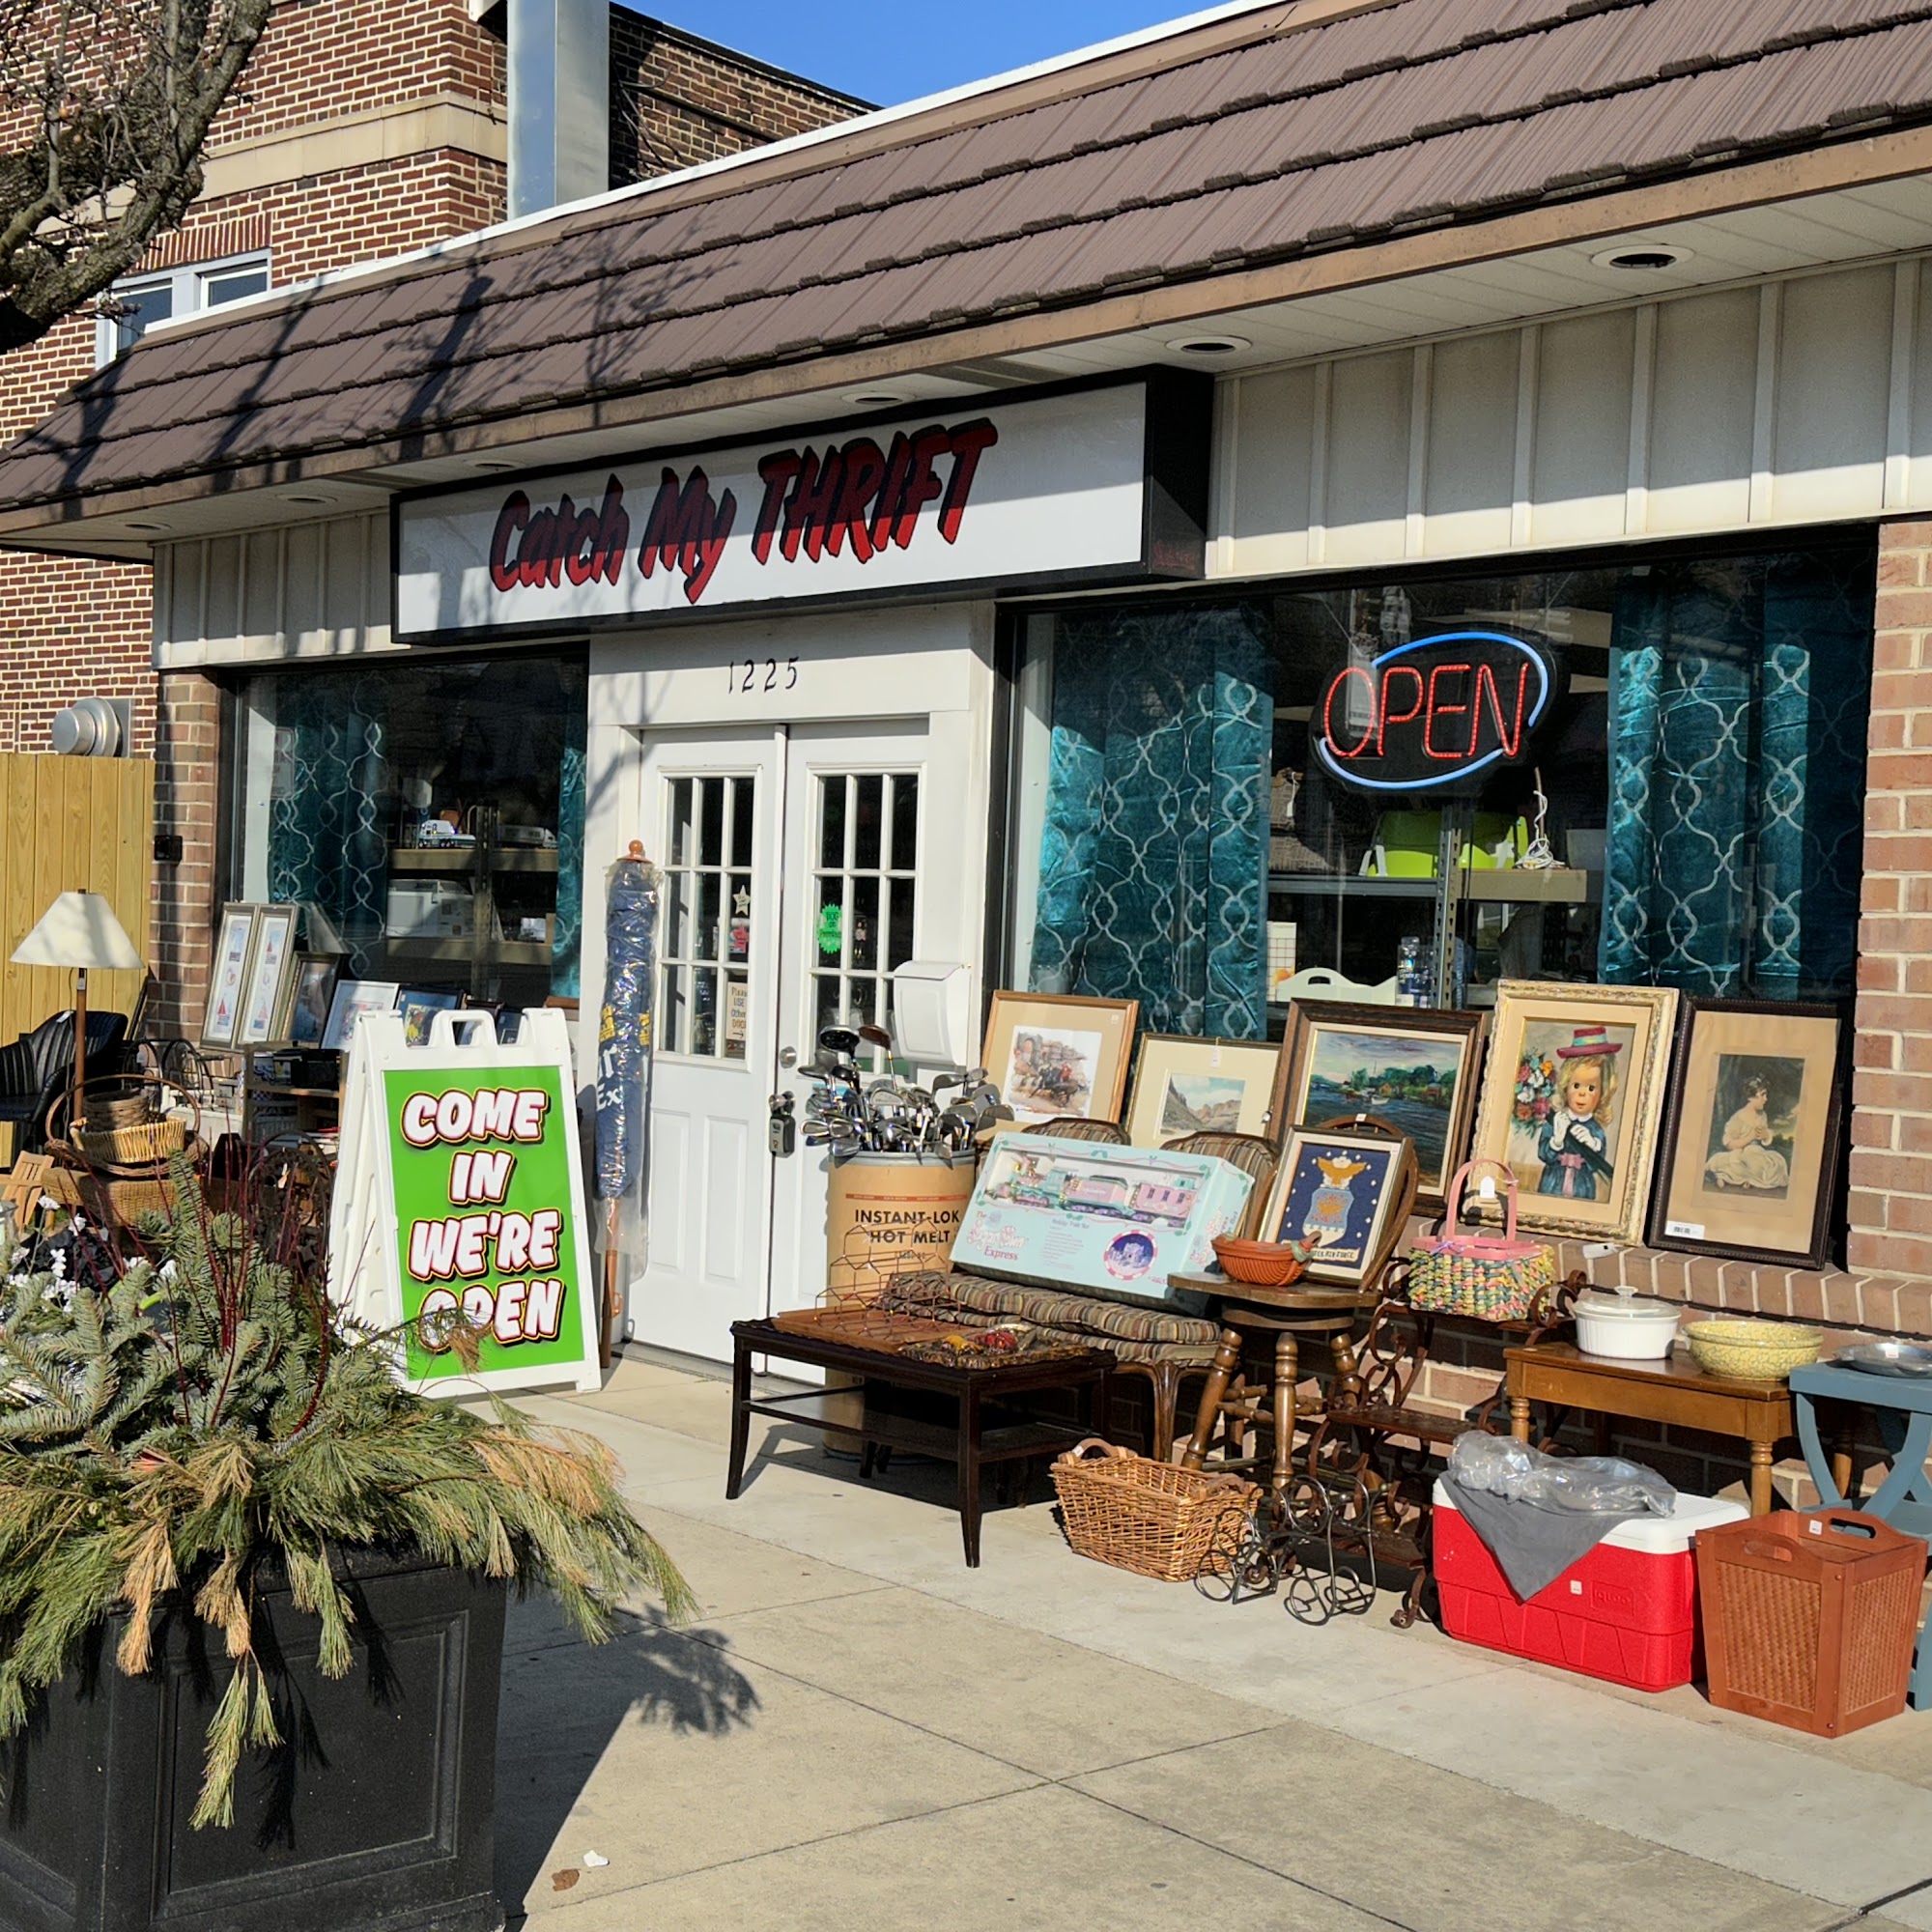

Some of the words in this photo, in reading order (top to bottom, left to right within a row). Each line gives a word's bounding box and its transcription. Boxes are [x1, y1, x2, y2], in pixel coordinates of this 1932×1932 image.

[490, 472, 630, 592] Catch
[638, 465, 737, 605] My
[752, 416, 998, 565] THRIFT
[728, 656, 800, 694] 1225
[1323, 663, 1529, 759] OPEN
[401, 1089, 550, 1147] COME
[448, 1150, 515, 1206] IN
[855, 1208, 960, 1225] INSTANT-LOK
[870, 1231, 906, 1244] HOT
[913, 1230, 951, 1244] MELT
[407, 1208, 563, 1283] WE'RE
[984, 1244, 1018, 1261] Express
[418, 1278, 564, 1352] OPEN
